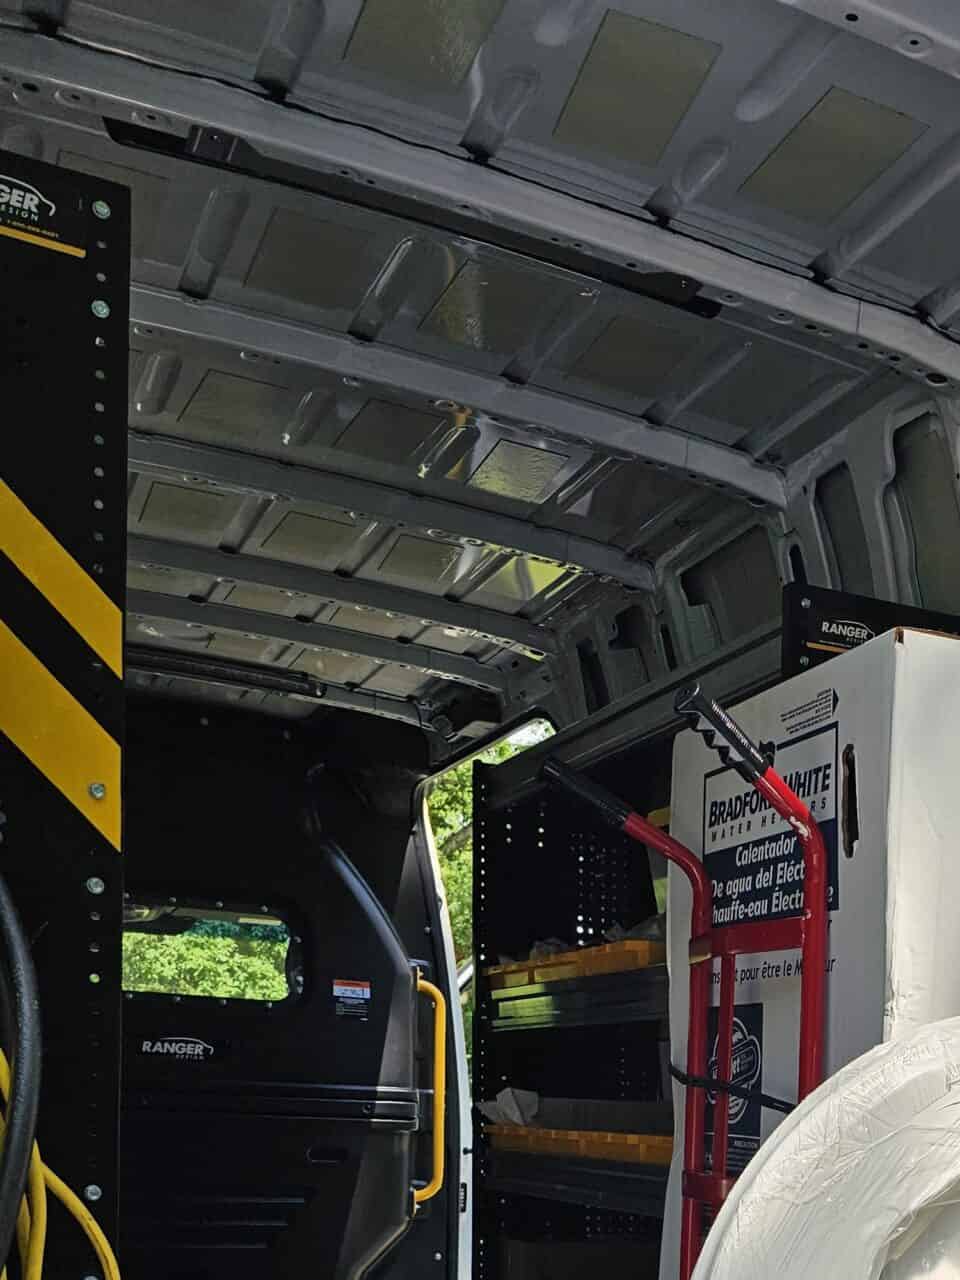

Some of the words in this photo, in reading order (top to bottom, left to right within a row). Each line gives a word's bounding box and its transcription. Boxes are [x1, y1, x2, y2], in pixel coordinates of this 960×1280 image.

[821, 621, 869, 640] RANGER
[708, 789, 773, 828] BRADFOR
[783, 763, 832, 797] WHITE
[712, 819, 752, 842] WATER
[735, 834, 798, 867] Calentador
[726, 876, 752, 900] agua
[755, 866, 773, 889] del
[712, 898, 769, 924] hauffe-eau
[739, 967, 760, 985] pour
[761, 960, 782, 979] être
[783, 961, 793, 977] le
[142, 1041, 205, 1055] RANGER
